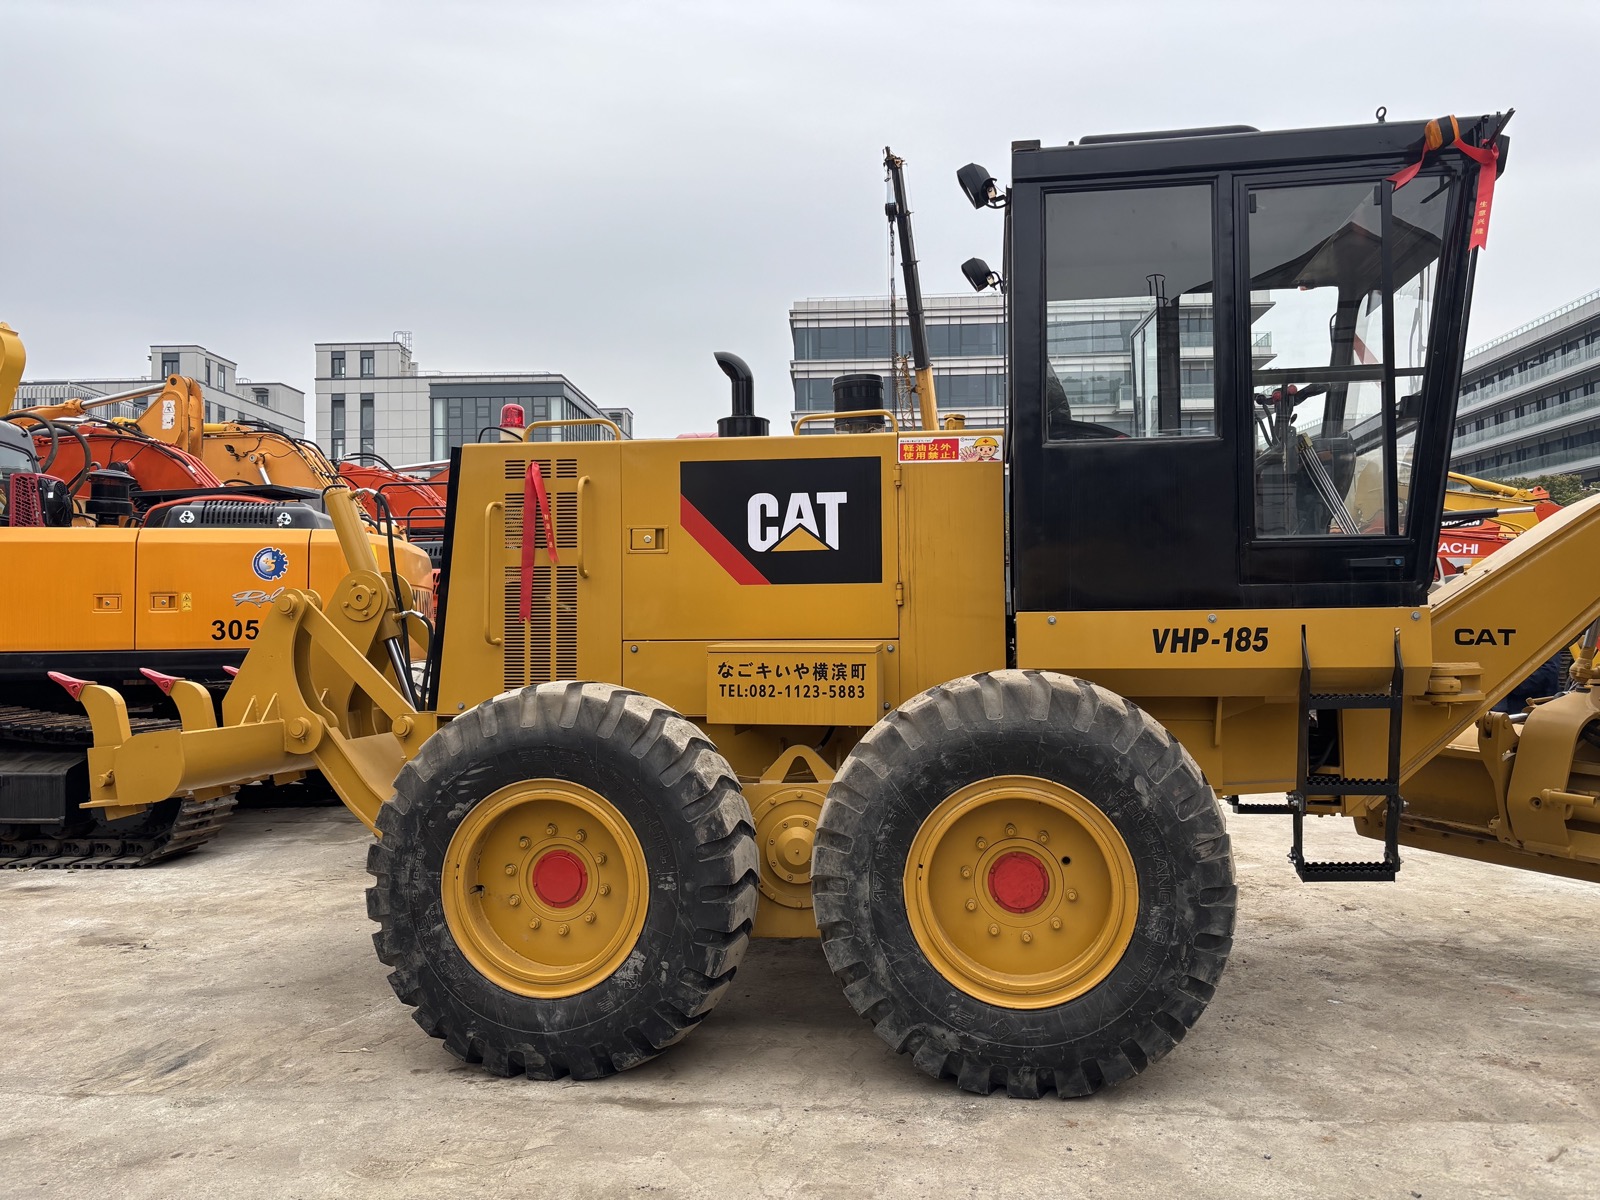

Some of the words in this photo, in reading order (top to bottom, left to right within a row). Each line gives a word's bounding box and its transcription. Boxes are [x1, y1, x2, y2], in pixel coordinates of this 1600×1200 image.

[747, 491, 848, 553] CAT
[1438, 542, 1479, 554] ACHI
[211, 619, 260, 641] 305
[1454, 628, 1517, 646] CAT
[1152, 627, 1269, 654] VHP-185
[719, 684, 865, 699] TEL:082-1123-5883
